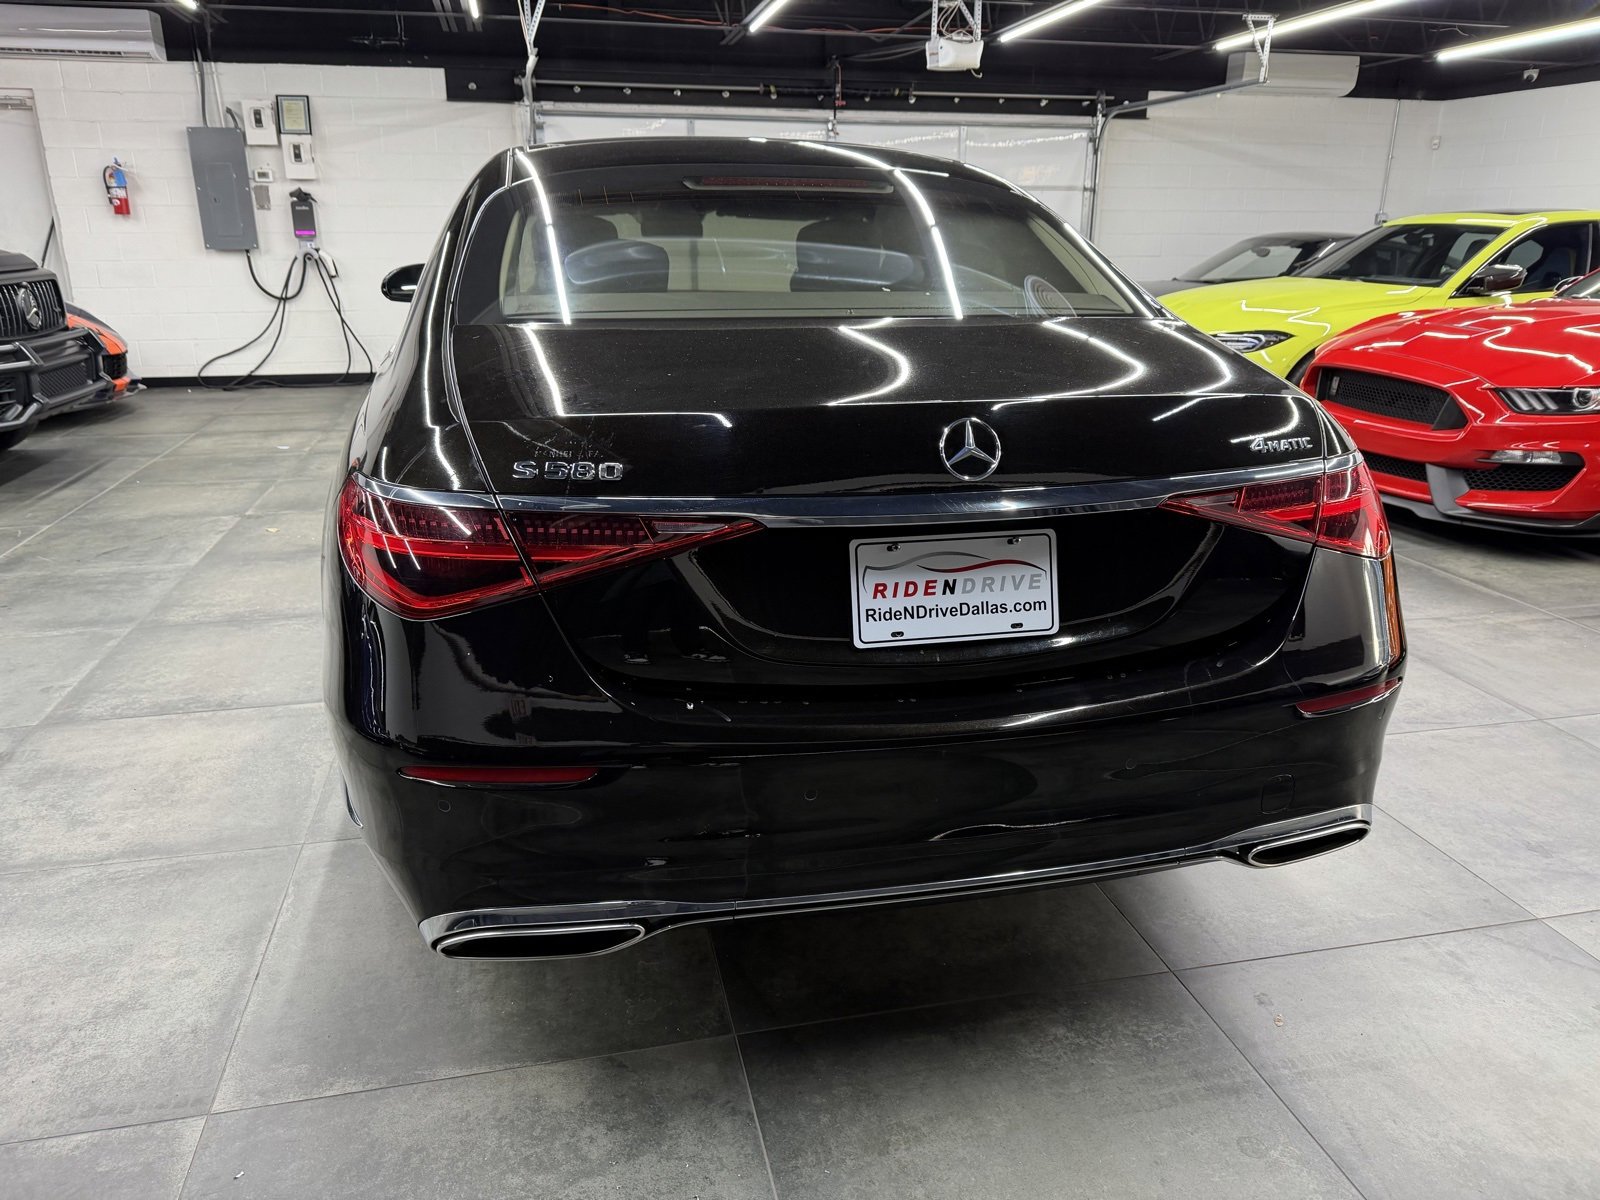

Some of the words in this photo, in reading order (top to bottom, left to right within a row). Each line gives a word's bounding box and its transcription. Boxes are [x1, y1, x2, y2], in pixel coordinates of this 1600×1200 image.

[1250, 437, 1313, 453] 4MATIC
[512, 460, 538, 479] S
[544, 461, 624, 481] 580
[865, 600, 1047, 623] RideNDriveDallas.com
